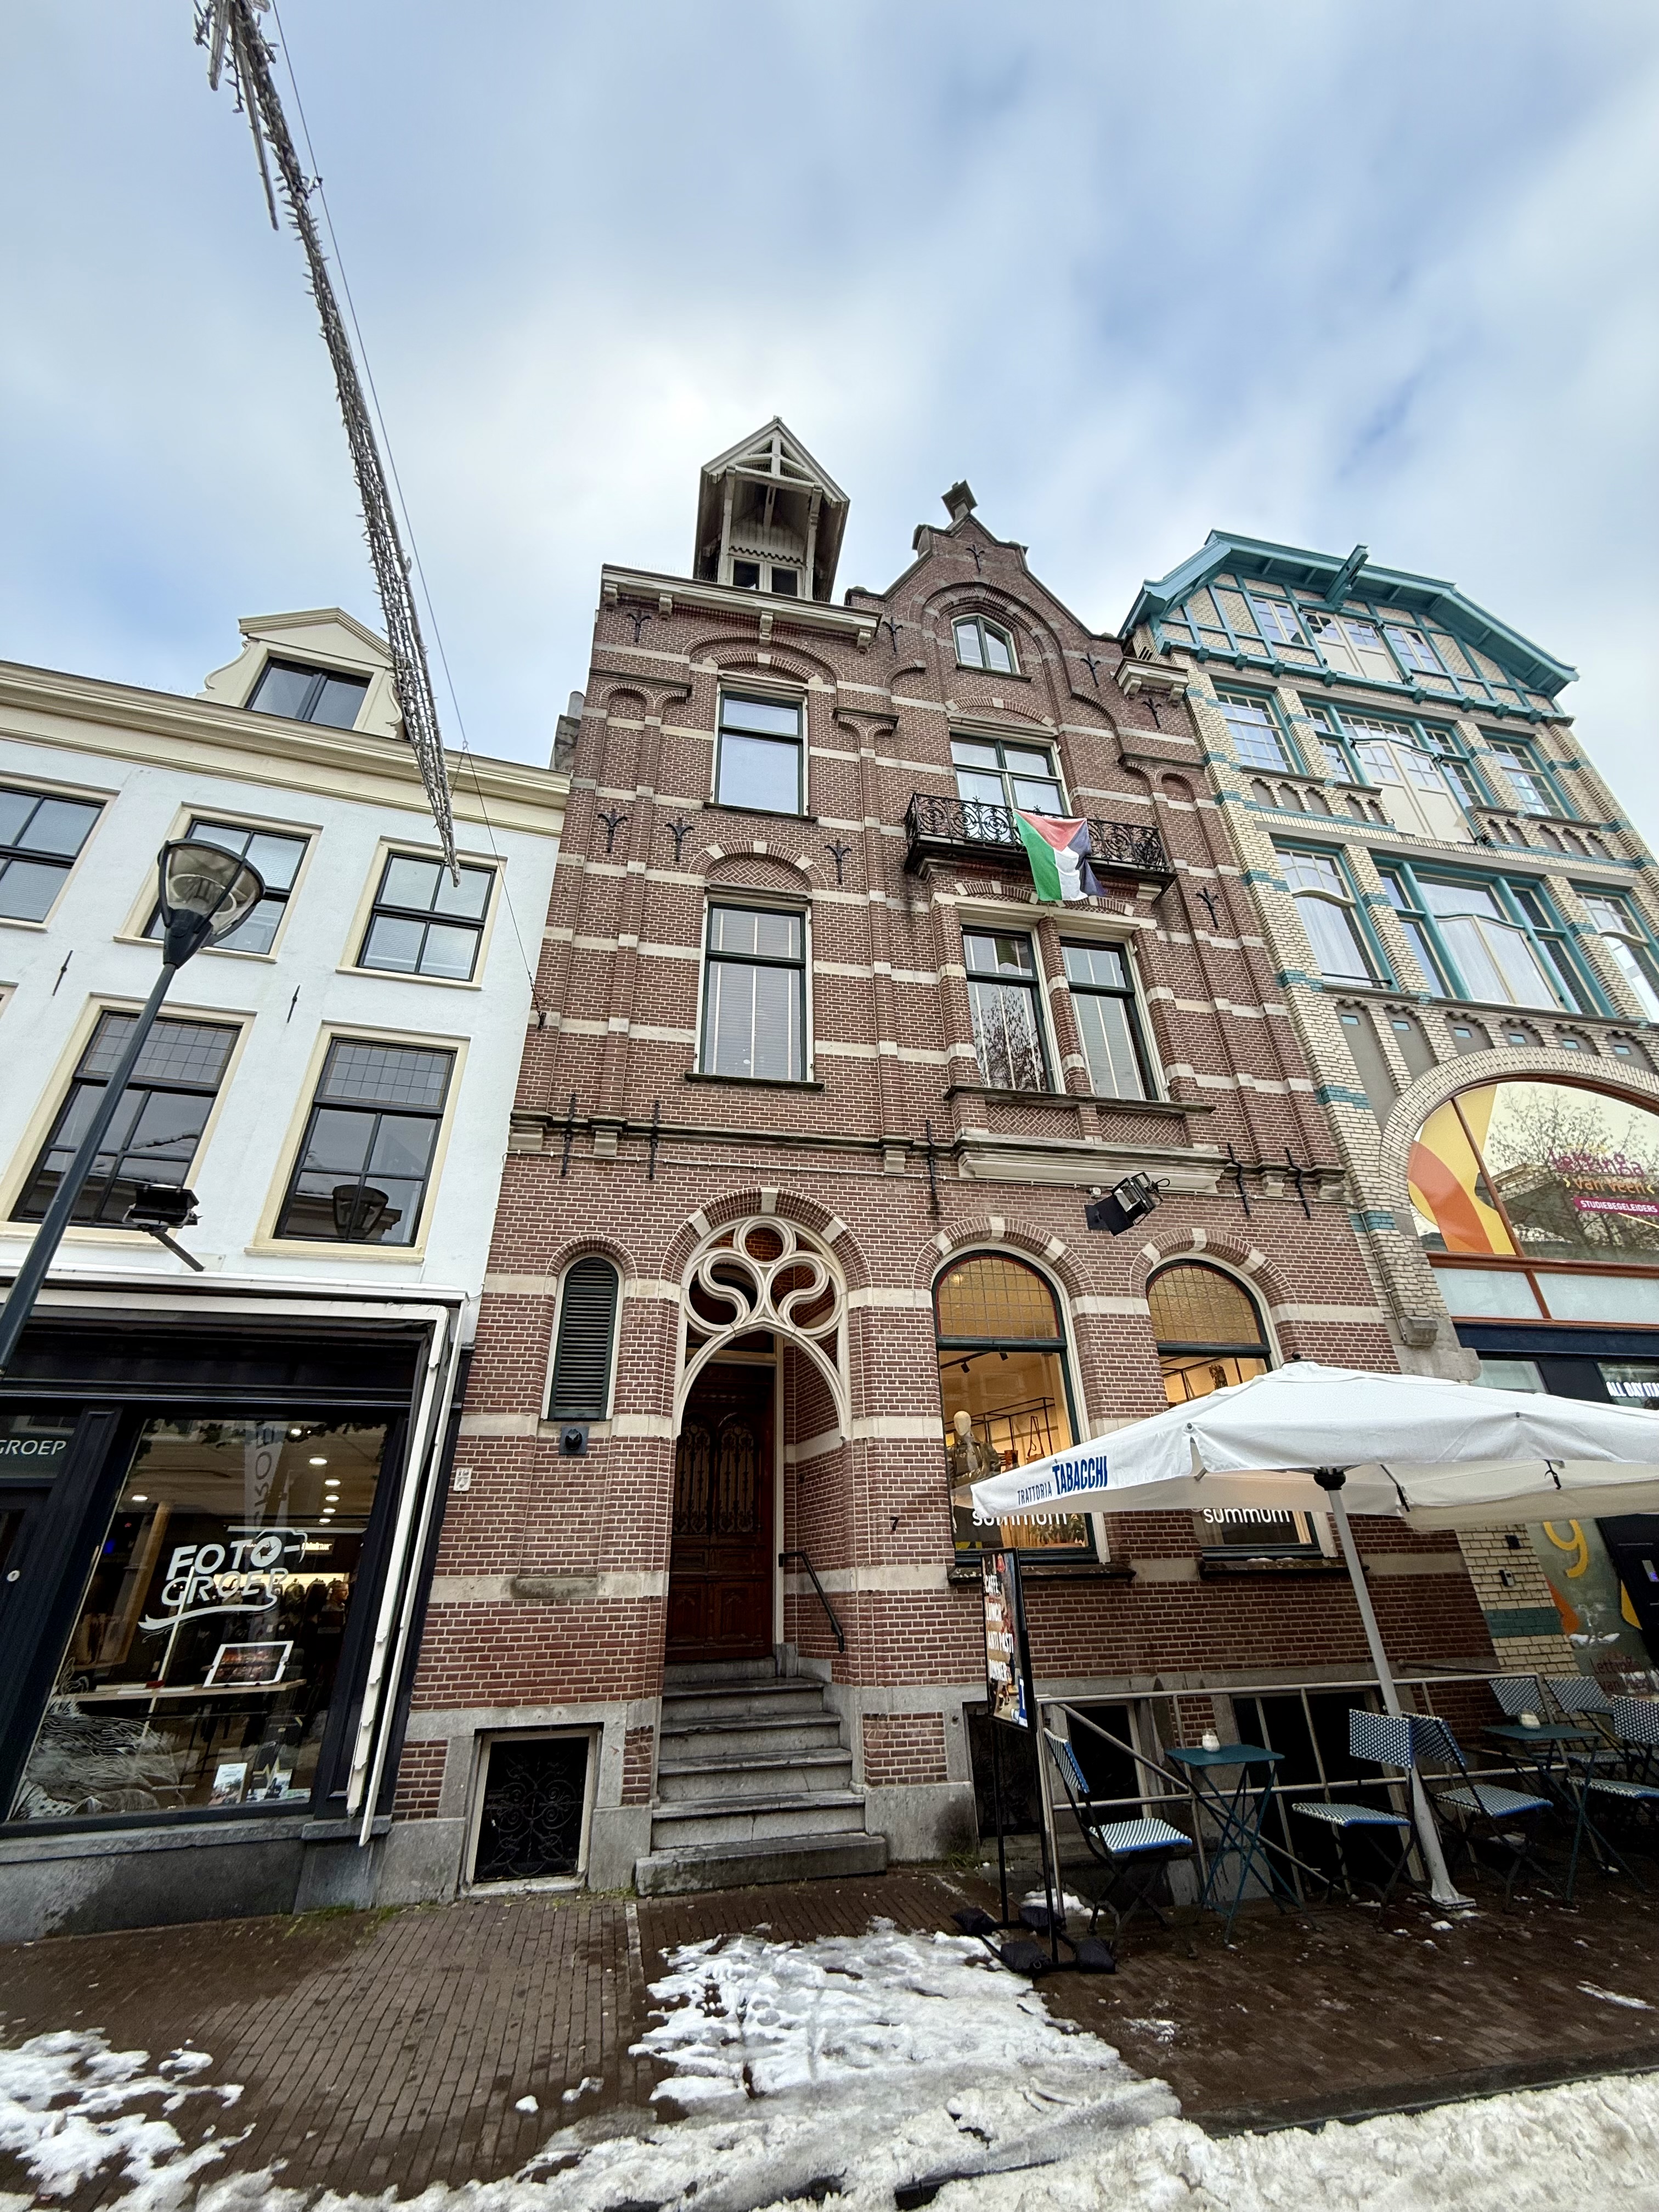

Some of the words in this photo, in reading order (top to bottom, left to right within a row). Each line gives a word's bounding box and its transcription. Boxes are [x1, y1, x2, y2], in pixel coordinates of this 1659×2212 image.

[1580, 1200, 1658, 1213] STUDIEBEGELEIDERS
[1606, 1381, 1627, 1397] ALL
[1623, 1382, 1645, 1397] DAY
[1017, 1481, 1053, 1505] TRATTORIA
[1052, 1455, 1108, 1495] TABACCHI
[889, 1516, 900, 1531] 7
[1203, 1508, 1290, 1523] summum
[161, 1567, 289, 1606] GROEP
[986, 1602, 1002, 1622] LUNCH
[989, 1658, 1008, 1682] DINNER
